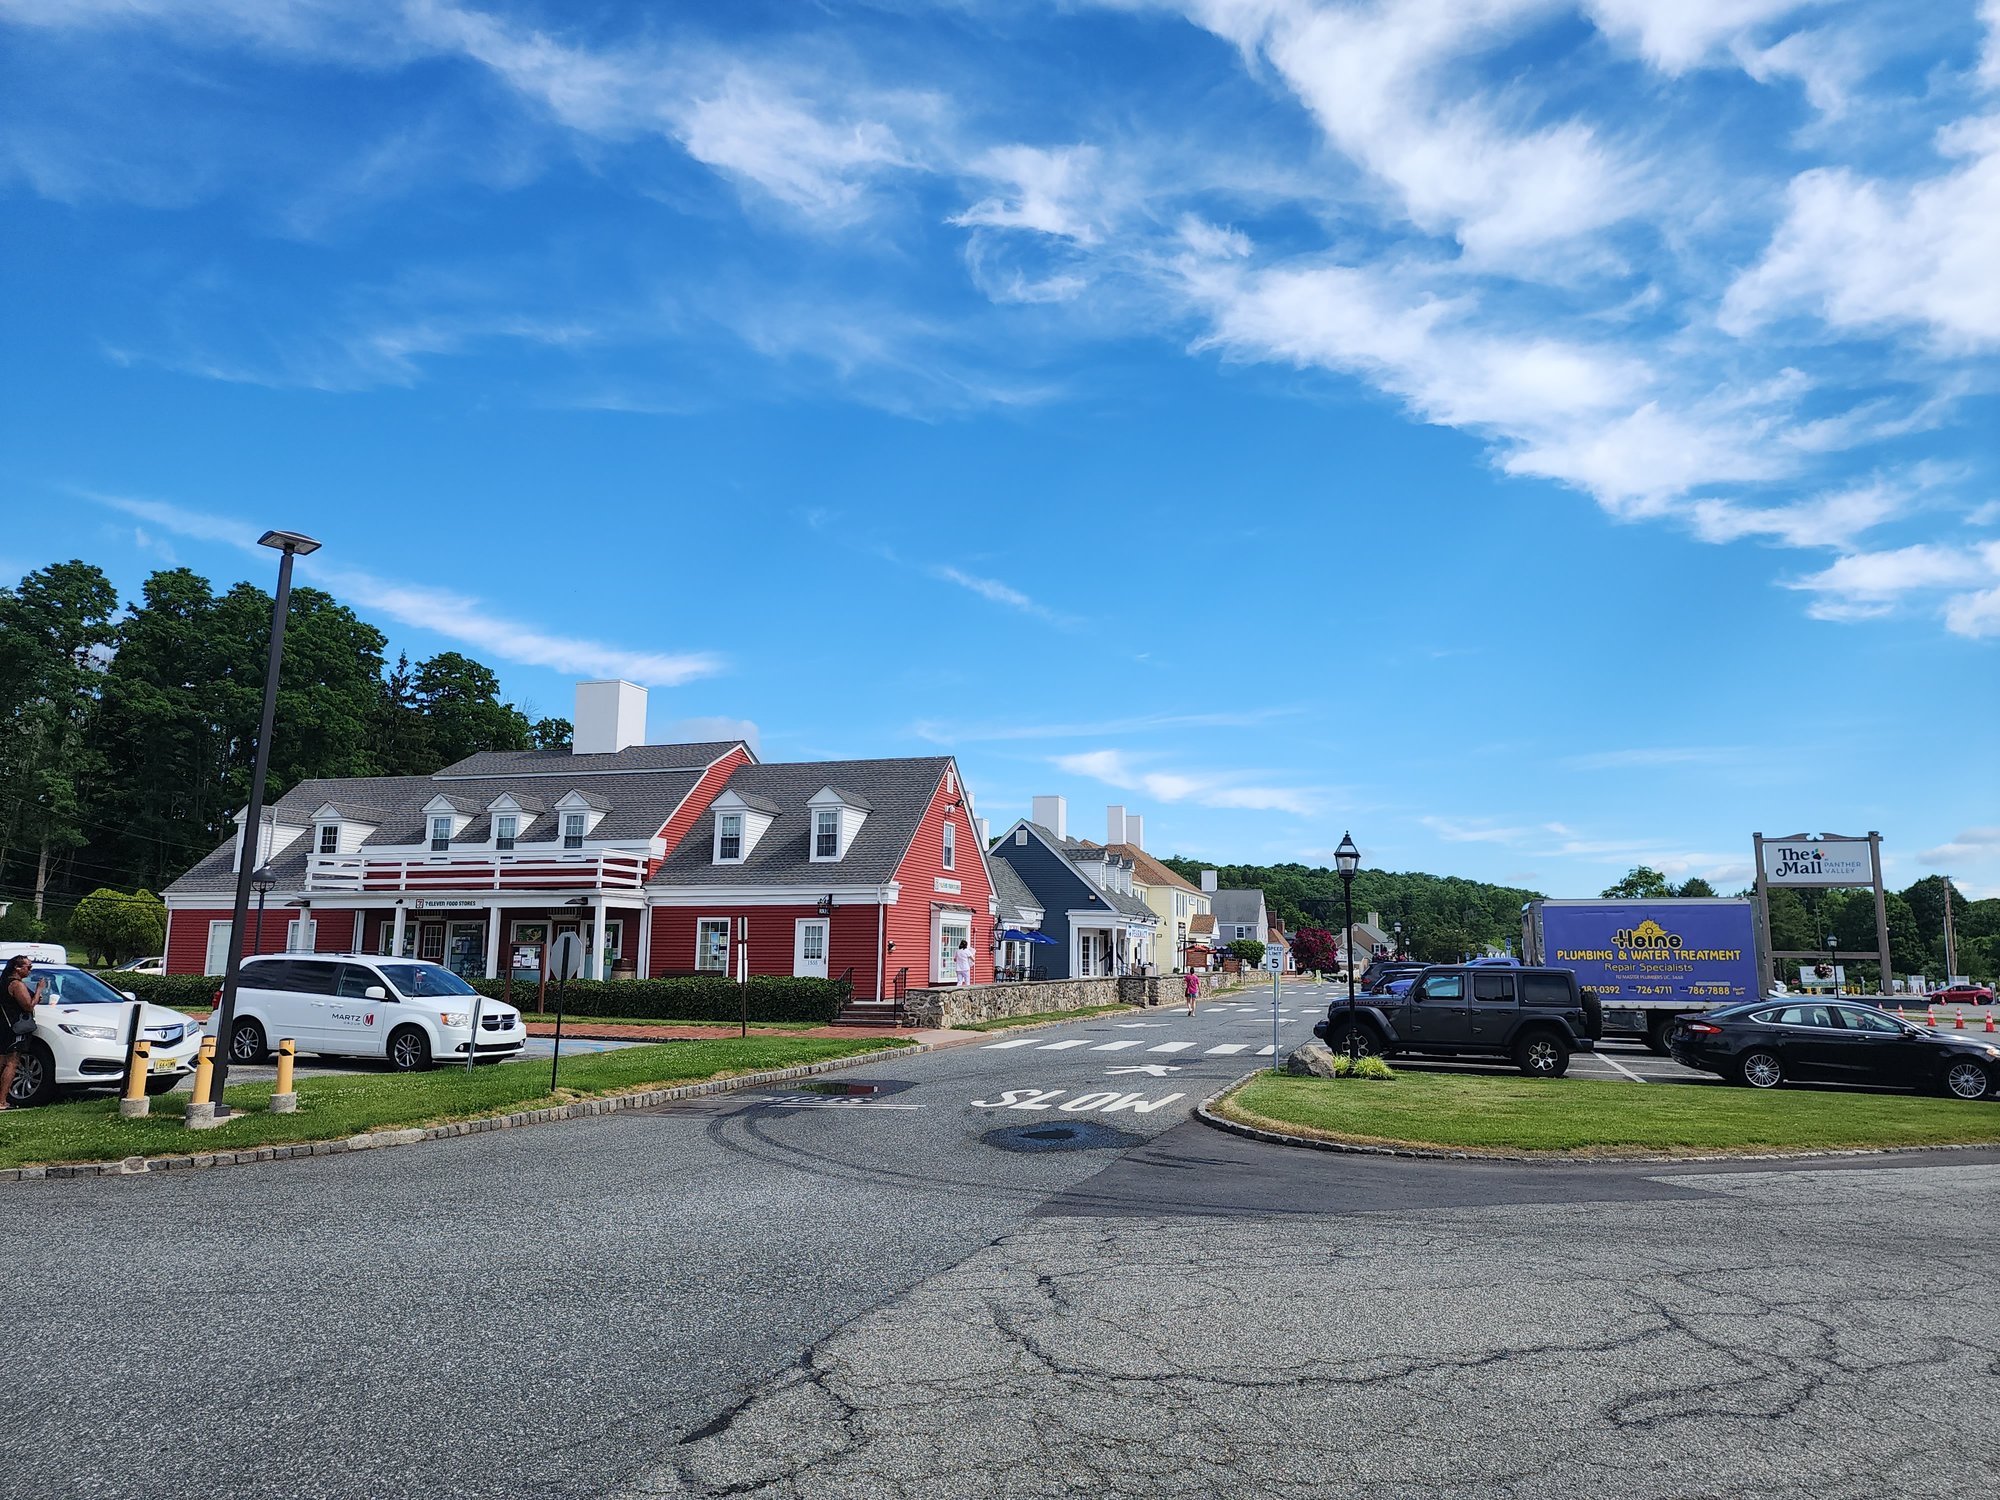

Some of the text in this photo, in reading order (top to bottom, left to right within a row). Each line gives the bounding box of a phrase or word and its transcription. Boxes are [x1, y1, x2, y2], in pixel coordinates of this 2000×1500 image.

[1778, 848, 1810, 860] The
[1776, 861, 1822, 877] Mall
[1610, 928, 1683, 949] Heine
[1557, 950, 1741, 960] PLUMBING & WATER TREATMENT
[1271, 958, 1279, 969] 5
[1604, 962, 1694, 973] Repair Specialists
[331, 1013, 360, 1021] MARTZ
[971, 1089, 1186, 1113] SLOW
